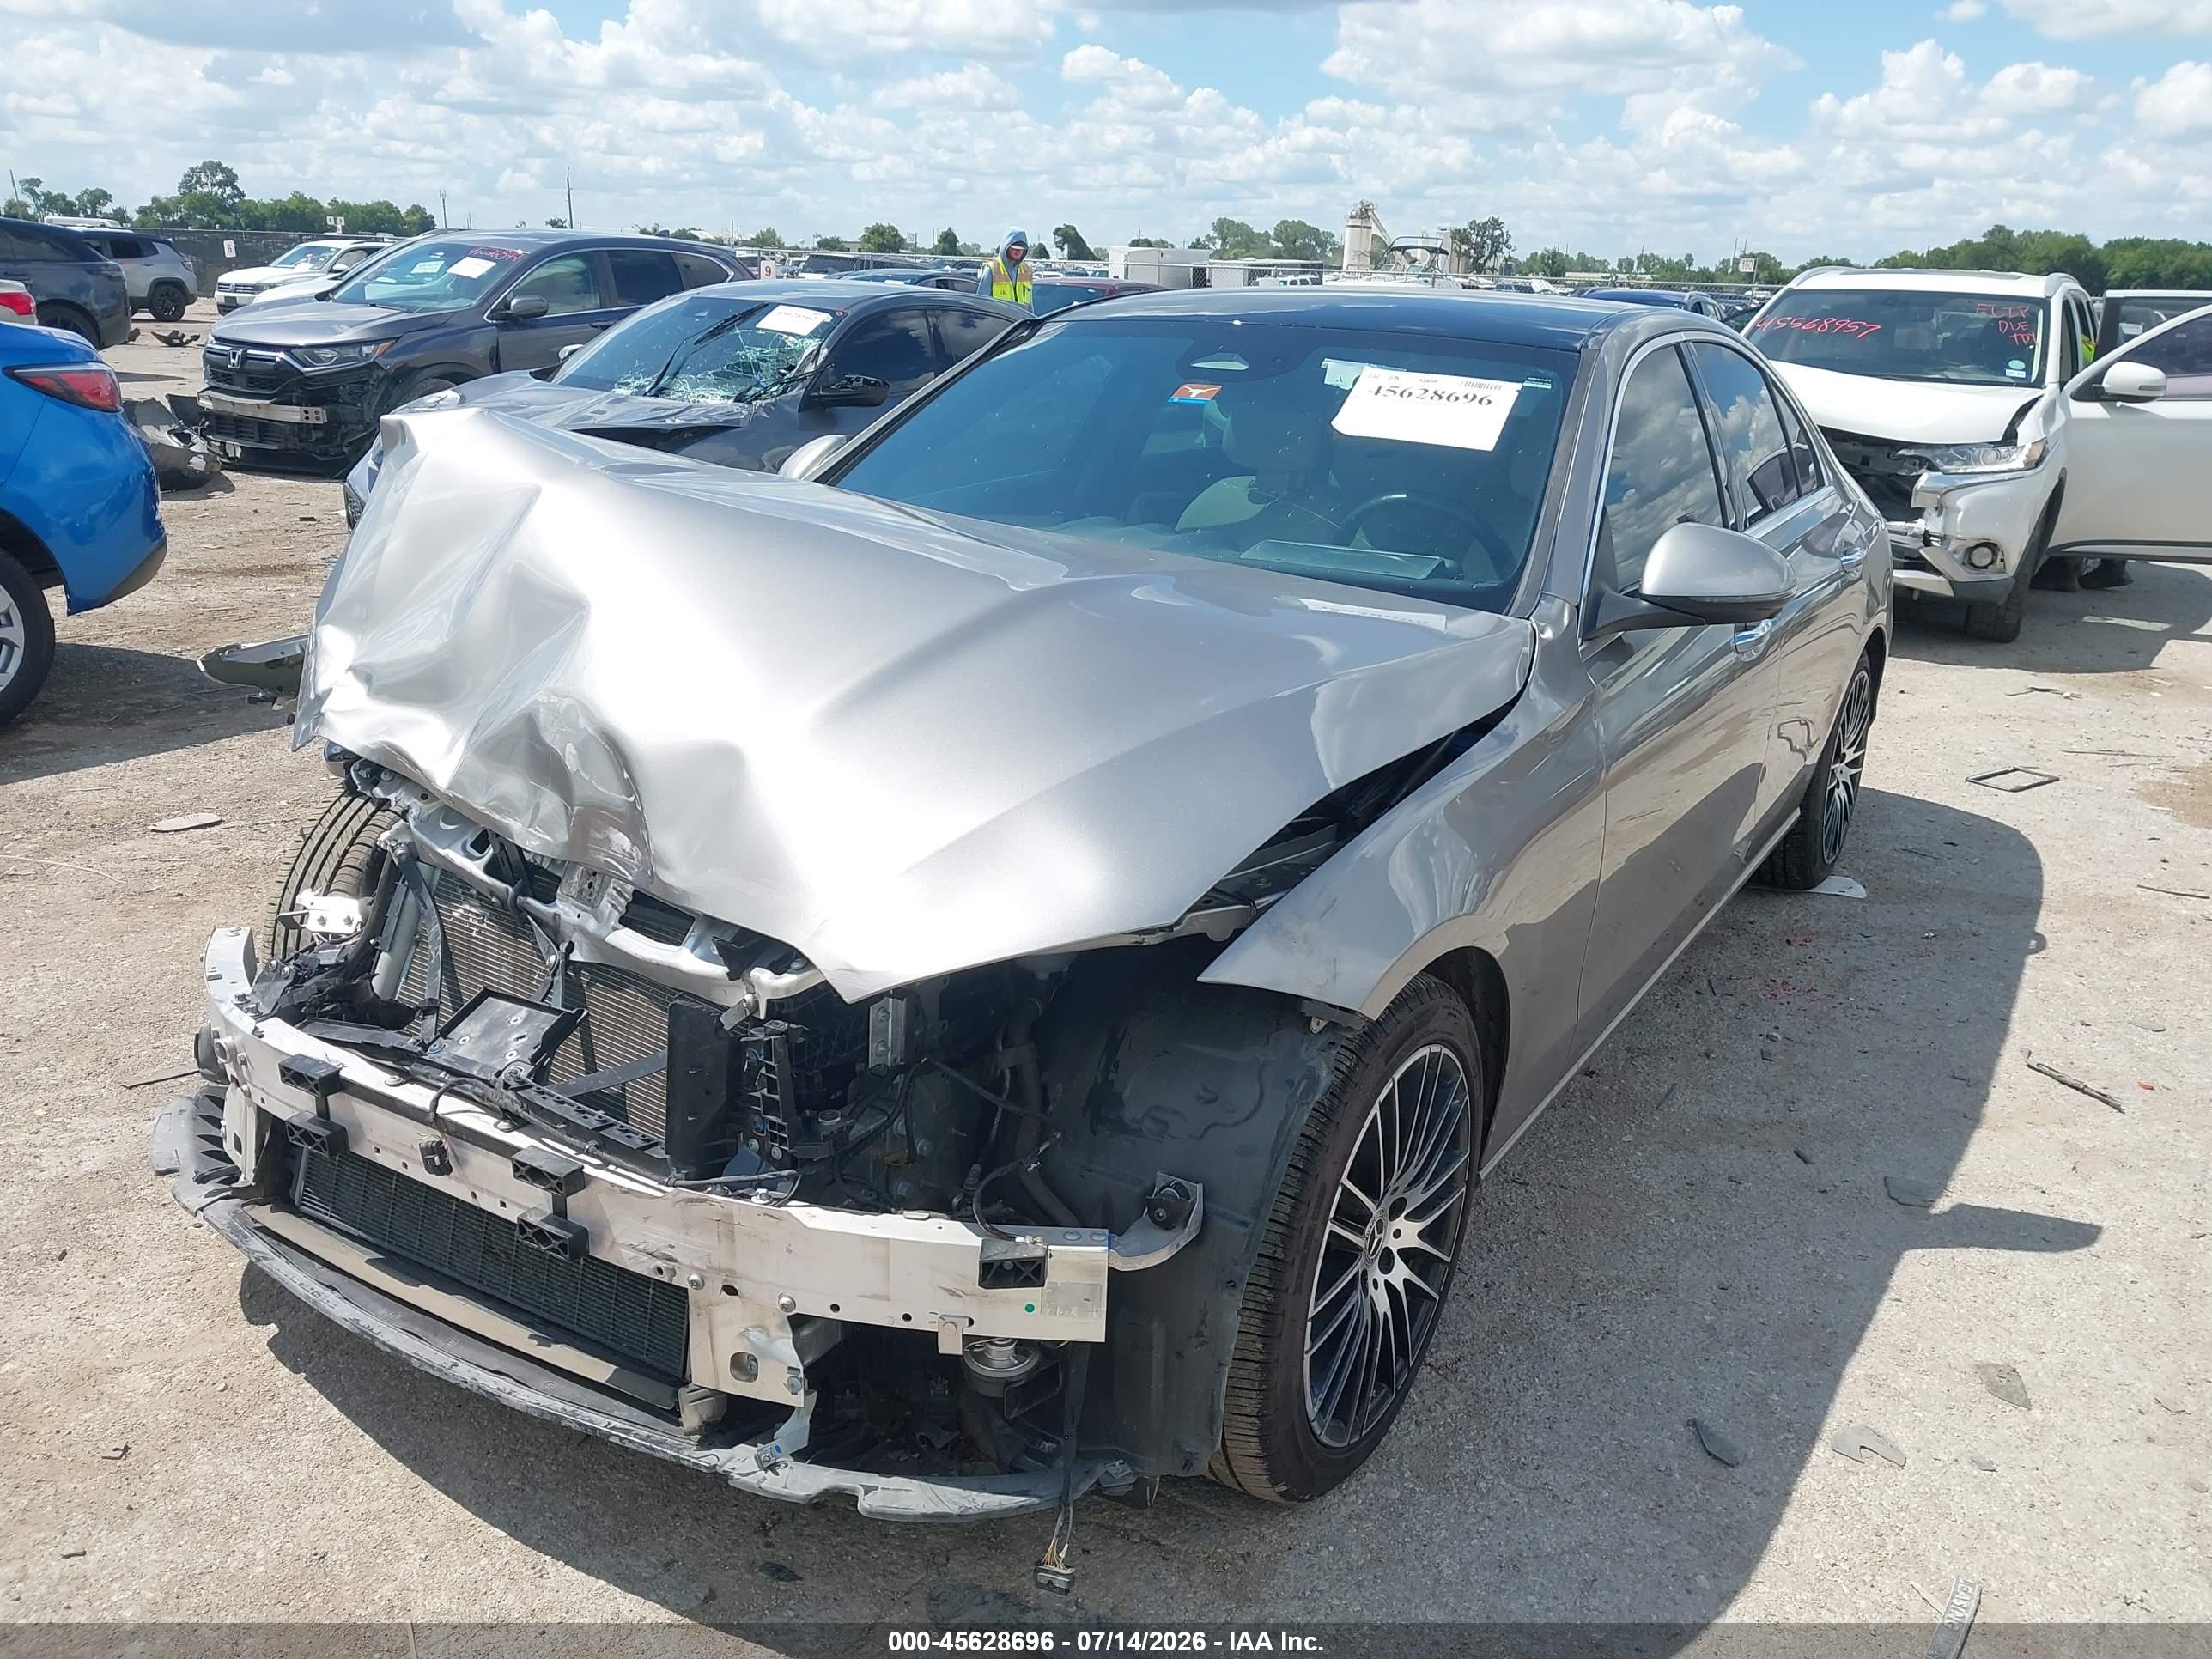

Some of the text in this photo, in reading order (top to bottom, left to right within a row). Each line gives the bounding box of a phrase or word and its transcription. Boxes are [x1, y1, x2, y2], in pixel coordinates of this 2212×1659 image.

[764, 265, 772, 276] 9
[1975, 302, 2030, 319] FLIP
[1755, 314, 1883, 340] 45568957
[1997, 319, 2030, 334] DUE
[1367, 385, 1492, 406] 45628696
